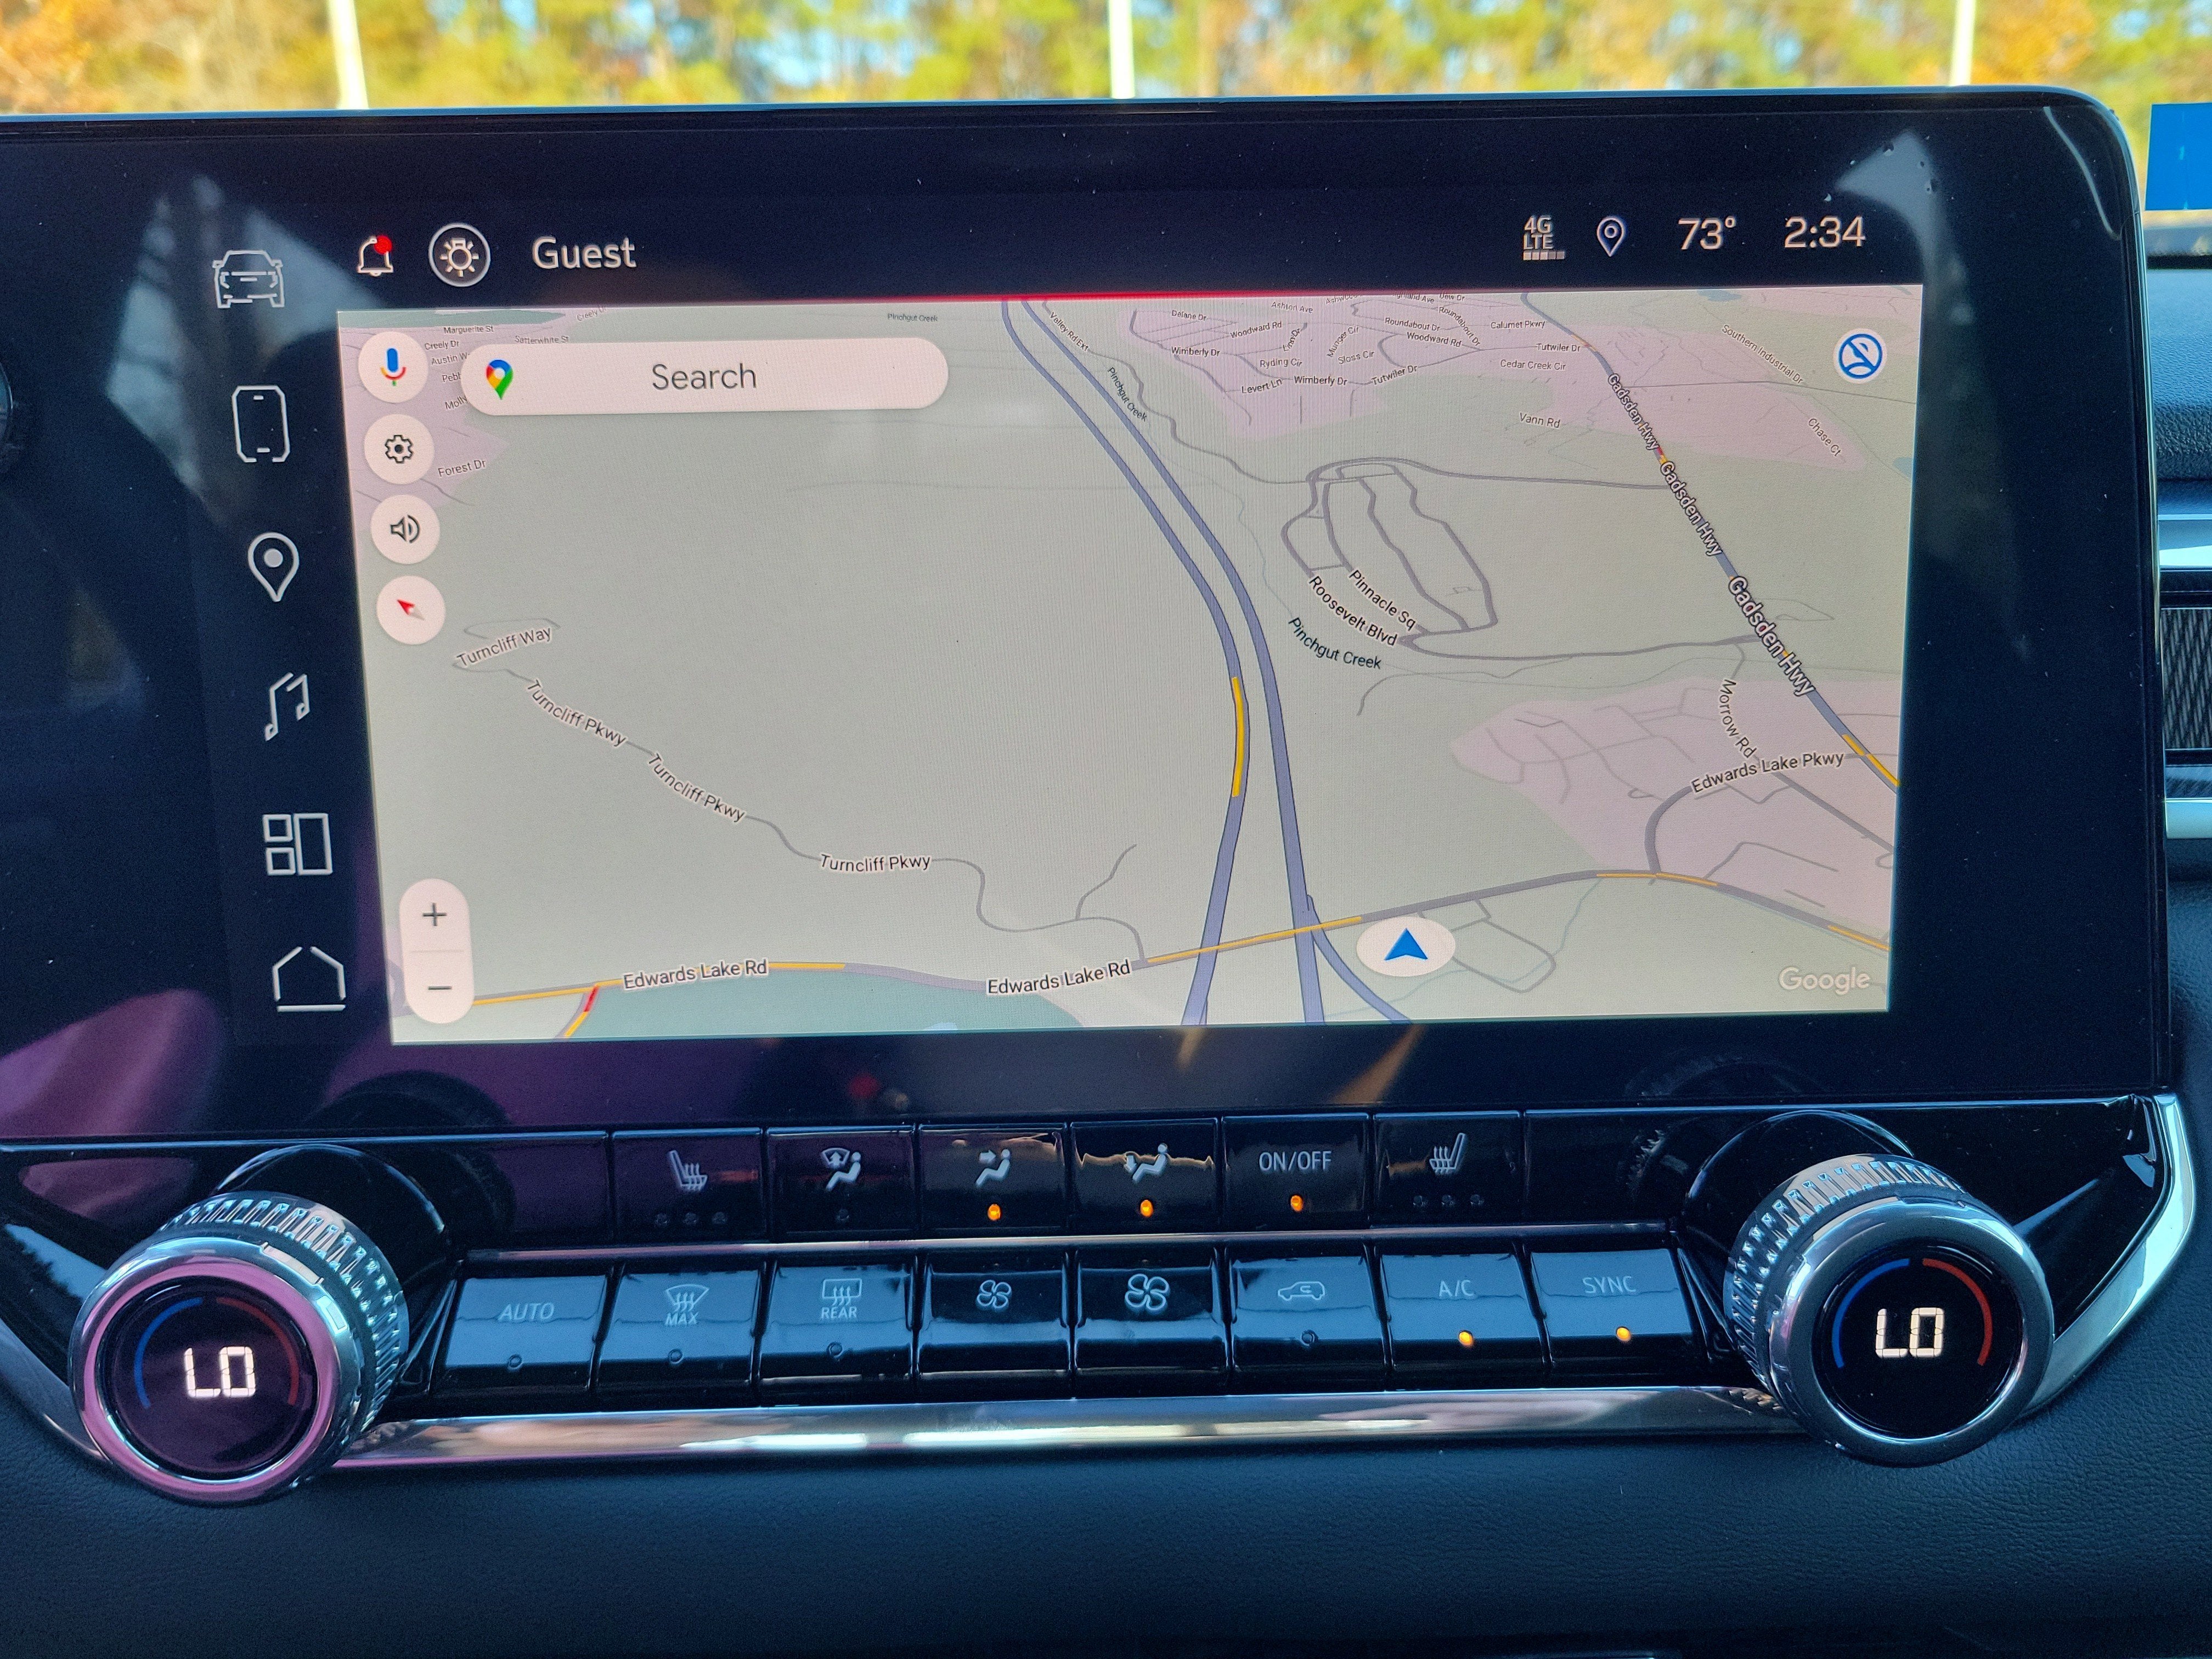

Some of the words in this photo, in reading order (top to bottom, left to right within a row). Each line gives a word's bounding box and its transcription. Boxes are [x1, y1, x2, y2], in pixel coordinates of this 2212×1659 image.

[1524, 215, 1553, 234] 4G
[1784, 216, 1866, 248] 2:34
[532, 235, 637, 269] Guest
[1523, 233, 1554, 250] LTE
[443, 326, 484, 335] Marguerite
[1050, 311, 1069, 334] Valley
[1067, 330, 1077, 343] Rd
[1076, 339, 1089, 352] Ext
[1231, 323, 1271, 339] Woodward
[1272, 320, 1282, 329] Rd
[1385, 317, 1430, 330] Roundabout
[1431, 324, 1441, 332] Dr
[1439, 306, 1474, 339] Roundabout
[1471, 336, 1481, 347] Dr
[1491, 321, 1523, 329] Calumet
[1407, 331, 1449, 345] Woodward
[1450, 338, 1462, 348] Rd
[1537, 343, 1570, 352] Tutwiler
[1571, 344, 1581, 353] Dr
[431, 355, 458, 366] Austin
[1171, 346, 1209, 357] Wimberly
[1210, 348, 1221, 357] Dr
[1721, 324, 1758, 352] Southern
[1757, 346, 1794, 379] Industrial
[1792, 372, 1804, 385] Dr
[1260, 358, 1289, 369] Ryding
[1290, 358, 1303, 367] Cir
[1500, 359, 1526, 369] Cedar
[1527, 360, 1552, 370] Creek
[1554, 362, 1566, 371] Cir
[652, 362, 757, 391] Search
[1294, 375, 1335, 387] Wimberly
[1337, 377, 1348, 385] Dr
[1371, 367, 1406, 385] Tutwiler
[1407, 364, 1418, 374] Dr
[1241, 382, 1271, 394] Levert
[1271, 379, 1283, 388] Ln
[1126, 402, 1148, 422] Creek
[1519, 412, 1544, 426] Vann
[1546, 416, 1561, 429] Rd
[1608, 373, 1644, 426] Gadsden
[1637, 421, 1660, 451] Hwy
[1808, 417, 1832, 446] Chase
[1830, 443, 1842, 458] Ct
[438, 462, 472, 477] Forest
[473, 460, 486, 470] Dr
[1660, 461, 1702, 525] Gadsden
[1696, 521, 1723, 556] Hwy
[1308, 575, 1366, 632] Roosevelt
[1366, 623, 1398, 646] Blvd
[1349, 569, 1398, 616] Pinnacle
[1398, 610, 1417, 631] Sq
[1288, 617, 1340, 662] Pinchgut
[1344, 651, 1382, 670] Creek
[1728, 575, 1786, 658] Gadsden
[1779, 651, 1816, 697] Hwy
[456, 634, 518, 667] Turncliff
[519, 627, 552, 646] Way
[527, 679, 583, 728] Turncliff
[584, 716, 627, 748] Pkwy
[1719, 679, 1739, 737] Morrow
[1735, 736, 1757, 759] Rd
[1691, 762, 1757, 793] Edwards
[1760, 755, 1798, 772] Lake
[1802, 752, 1844, 768] Pkwy
[648, 753, 706, 803] Turncliff
[703, 794, 746, 823] Pkwy
[821, 854, 885, 872] Turncliff
[889, 855, 930, 871] Pkwy
[623, 966, 696, 989] Edwards
[700, 961, 741, 978] Lake
[745, 958, 768, 975] Rd
[988, 974, 1060, 994] Edwards
[1064, 967, 1104, 986] Lake
[1108, 958, 1131, 978] Rd
[1778, 966, 1870, 996] Google
[1259, 1149, 1333, 1173] ON/OFF
[1438, 1279, 1472, 1299] A/C
[1582, 1275, 1637, 1295] SYNC
[498, 1302, 556, 1323] AUTO
[664, 1311, 699, 1327] MAX
[821, 1305, 858, 1320] REAR
